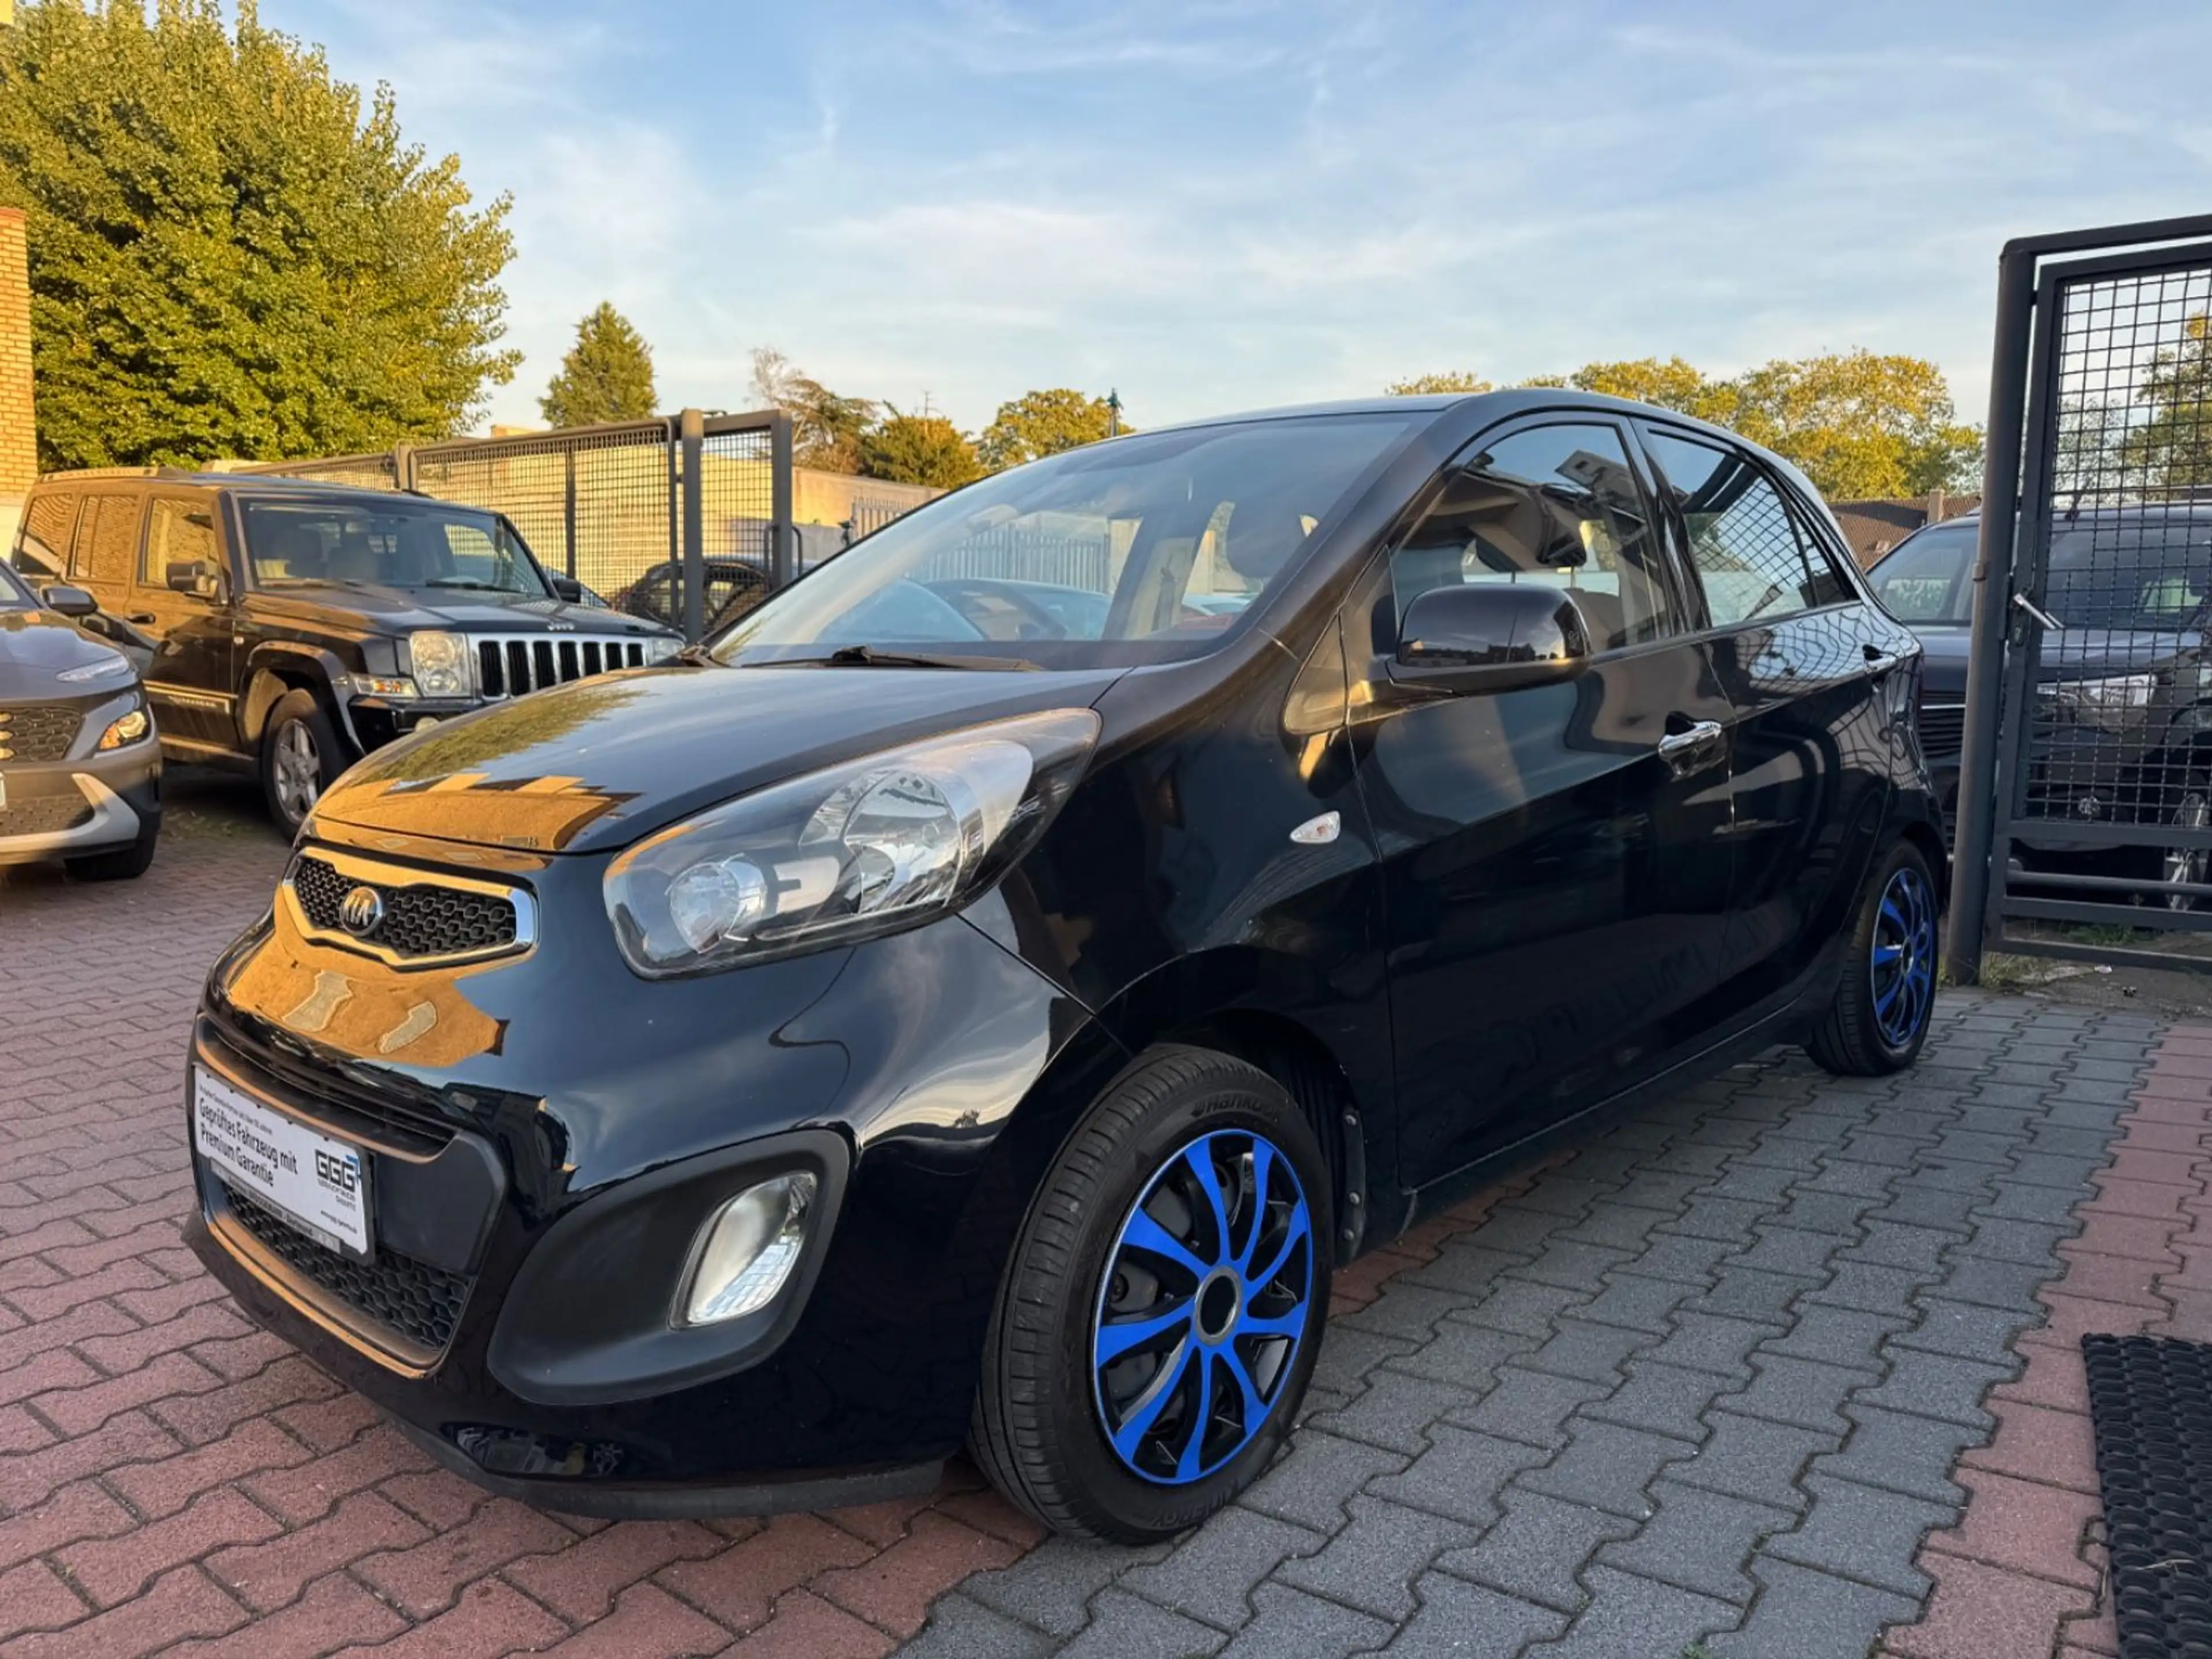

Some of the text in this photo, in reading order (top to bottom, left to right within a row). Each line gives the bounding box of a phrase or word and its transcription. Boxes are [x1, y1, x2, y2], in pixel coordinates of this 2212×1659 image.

[343, 894, 370, 926] KIA
[199, 1097, 236, 1138] Geprüftes
[237, 1121, 278, 1169] Fahrzeug
[280, 1150, 298, 1175] mit
[200, 1122, 274, 1187] Premium Garantie
